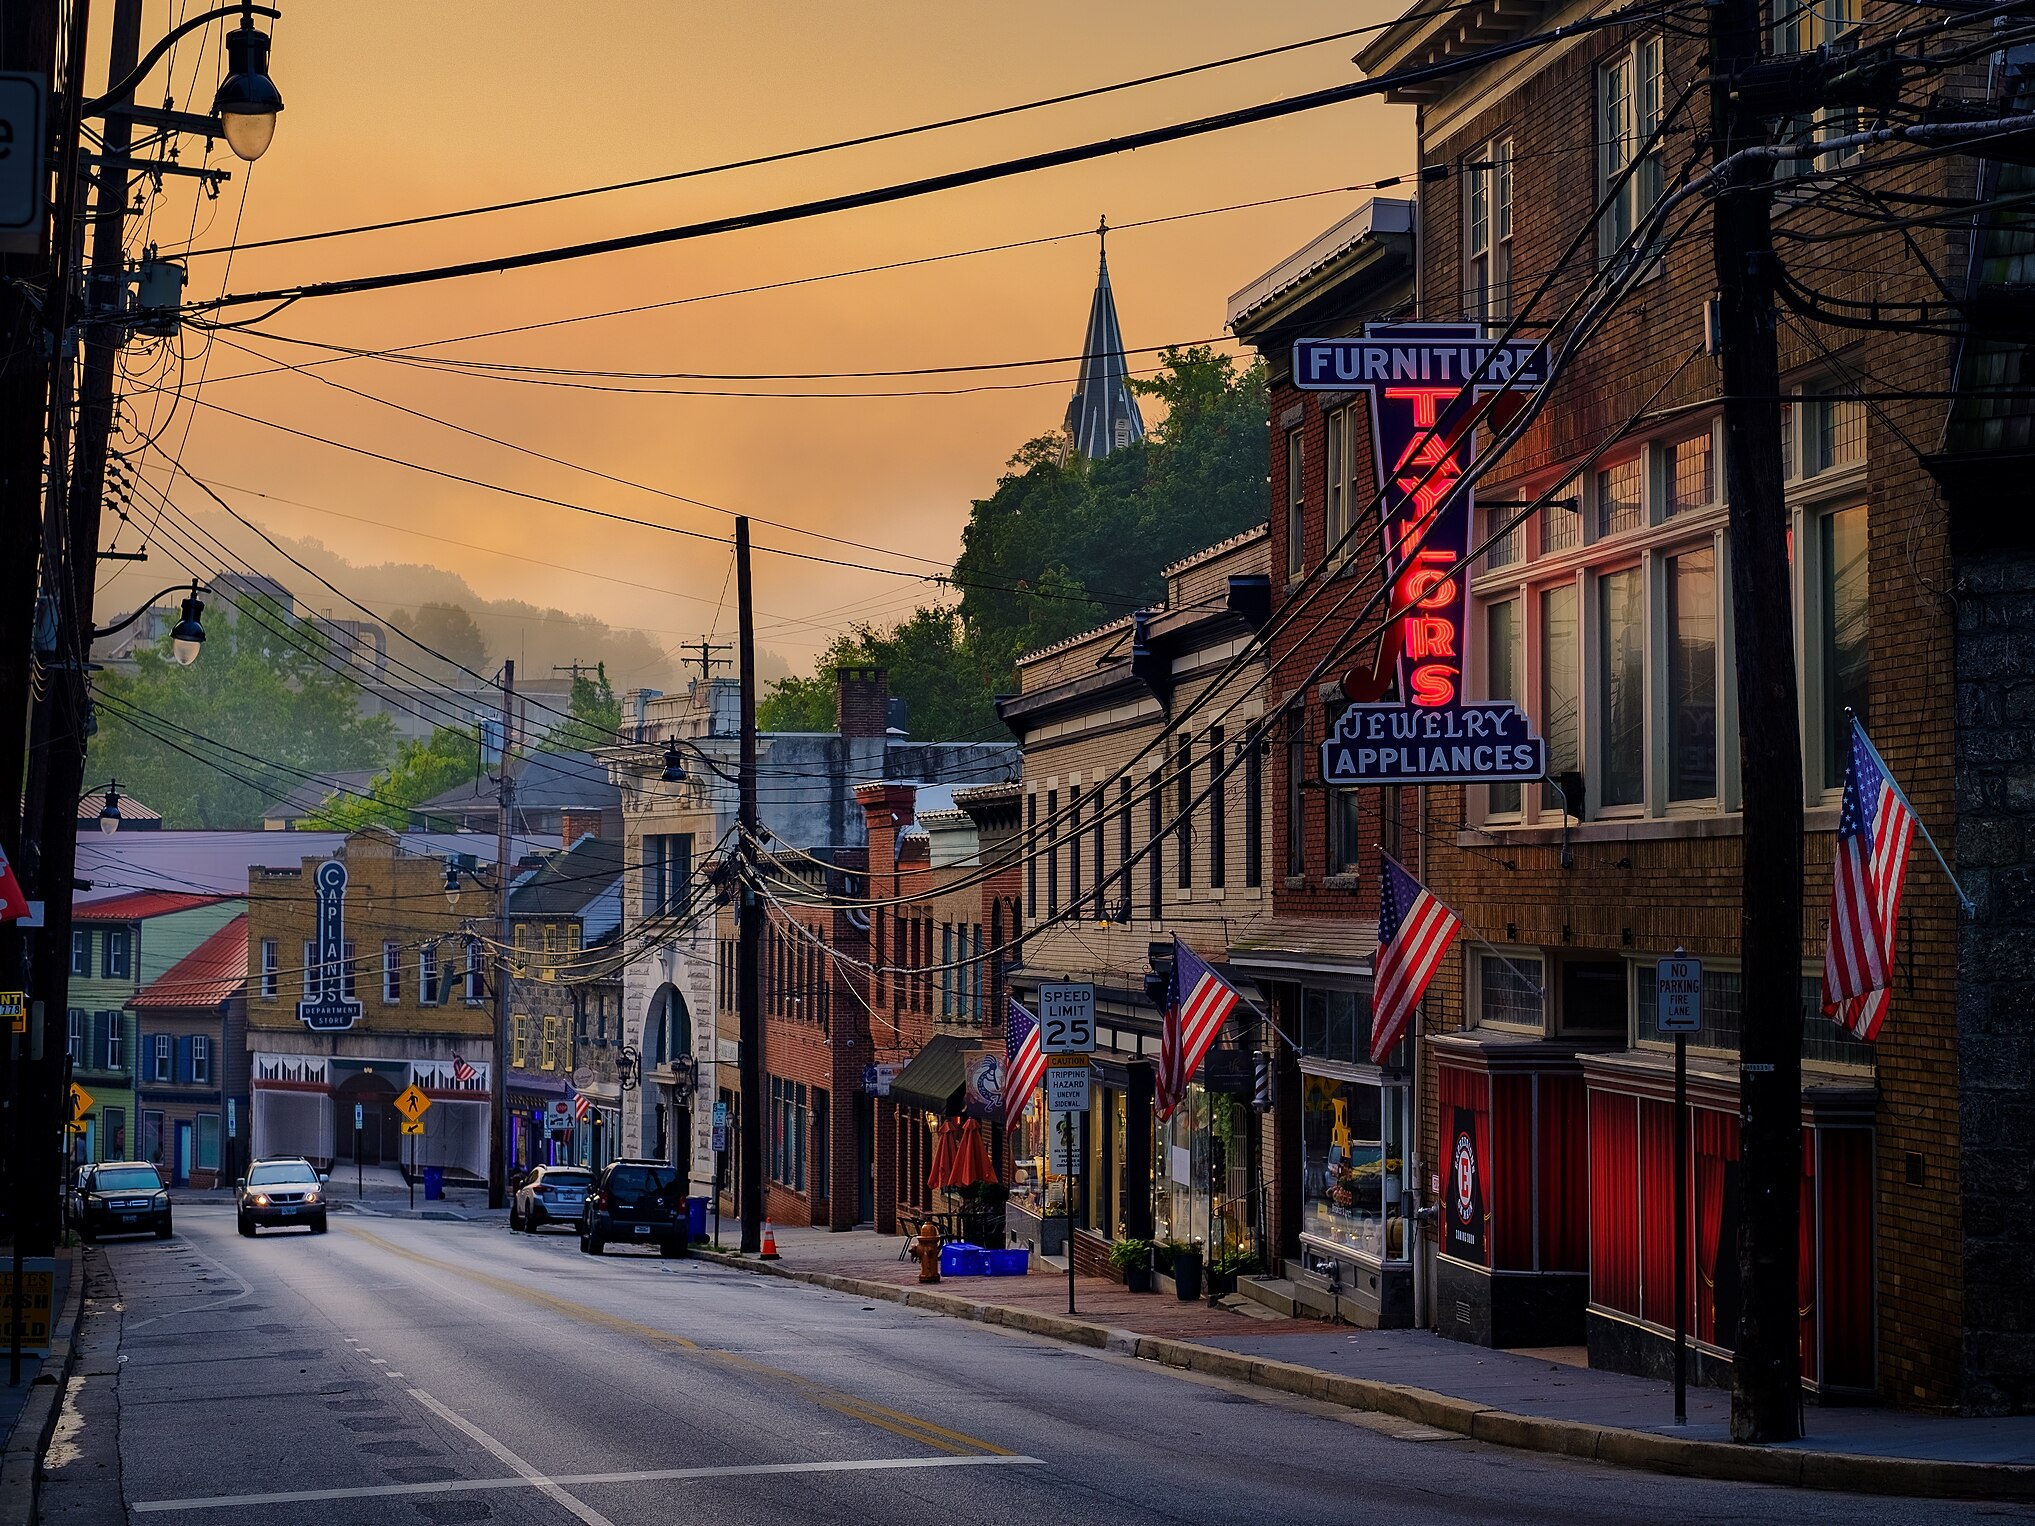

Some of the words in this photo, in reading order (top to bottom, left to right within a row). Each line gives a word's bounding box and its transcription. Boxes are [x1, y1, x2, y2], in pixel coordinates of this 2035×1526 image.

[1310, 347, 1540, 382] FURNITURE
[1342, 708, 1514, 739] JEWELRY
[1334, 744, 1535, 775] APPLIANCES
[325, 868, 340, 1002] CAPLAN'S
[1671, 963, 1688, 978] NO
[1659, 979, 1699, 994] PARKING
[1044, 990, 1091, 1003] SPEED
[1670, 994, 1689, 1005] FIRE
[305, 1006, 358, 1015] DEPARTMENT
[1049, 1005, 1086, 1017] LIMIT
[1668, 1006, 1690, 1016] LANE
[318, 1016, 344, 1025] STORE
[1046, 1019, 1090, 1046] 25
[1051, 1056, 1085, 1066] CAUTION
[1051, 1070, 1086, 1079] TRIPPING
[1053, 1080, 1084, 1089] HAZARD
